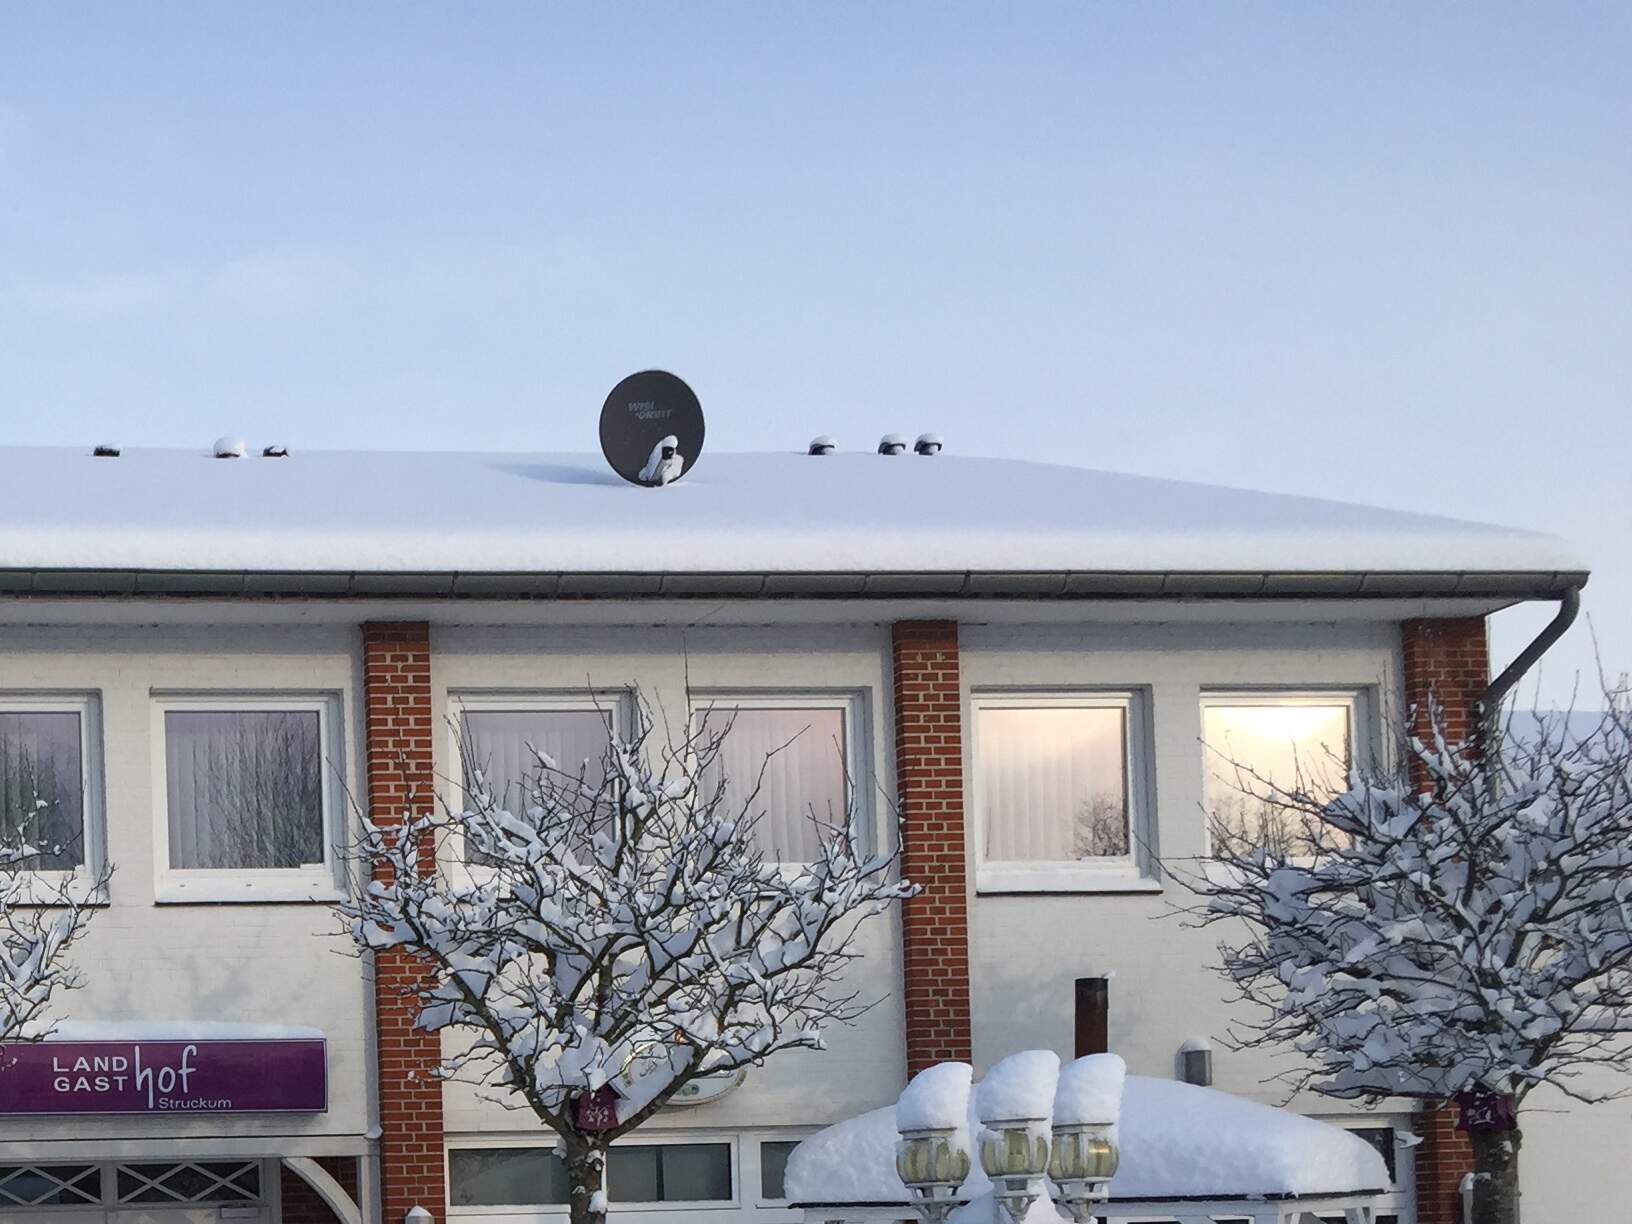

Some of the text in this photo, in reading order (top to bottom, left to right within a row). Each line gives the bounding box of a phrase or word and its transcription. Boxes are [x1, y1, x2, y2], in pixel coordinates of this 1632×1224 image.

[53, 1056, 128, 1072] LAND
[53, 1044, 198, 1109] GAST hof
[158, 1097, 232, 1109] Struckum
